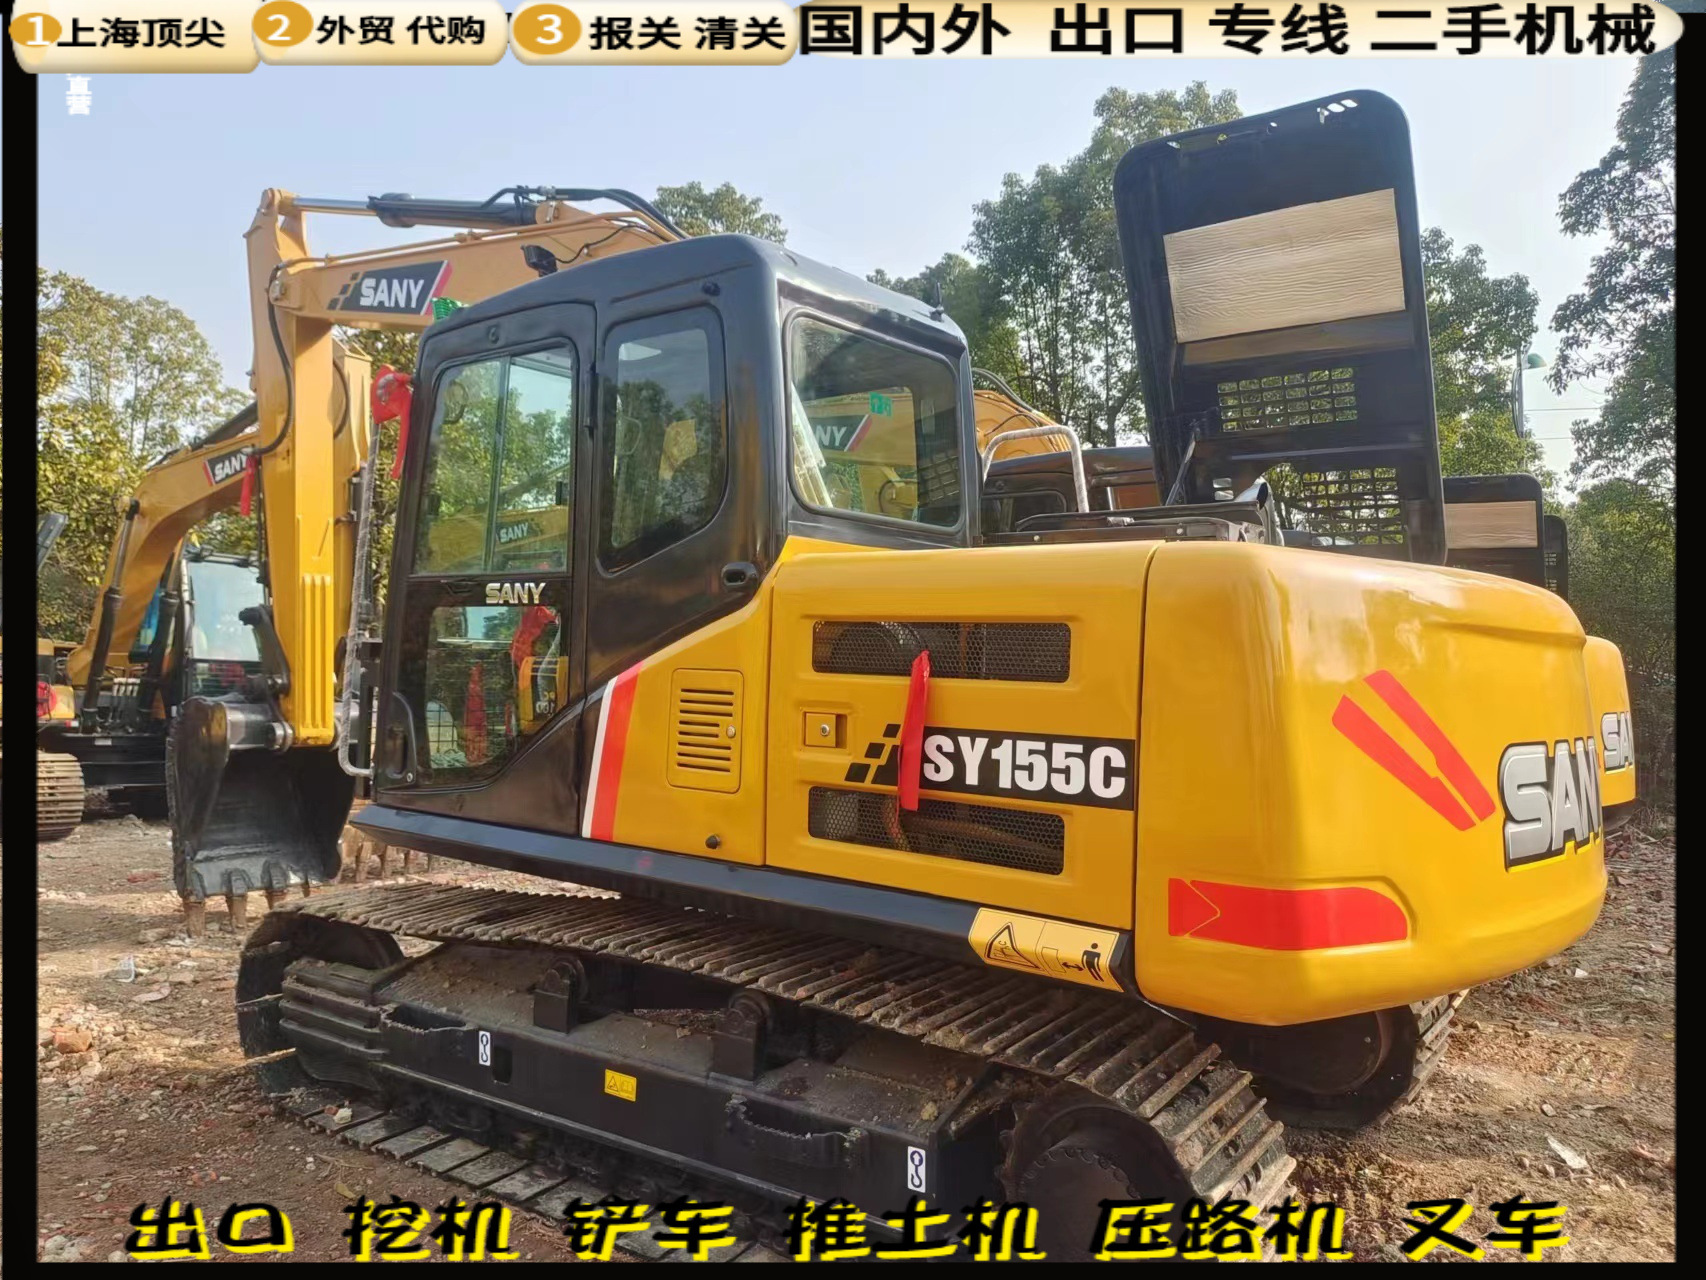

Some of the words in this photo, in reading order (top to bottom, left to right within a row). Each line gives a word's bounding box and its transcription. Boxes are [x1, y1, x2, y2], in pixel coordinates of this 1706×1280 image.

[359, 277, 425, 309] SANY
[214, 452, 248, 482] SANY
[500, 522, 529, 543] SANY
[485, 582, 546, 604] SANY
[923, 734, 1127, 799] SY155C
